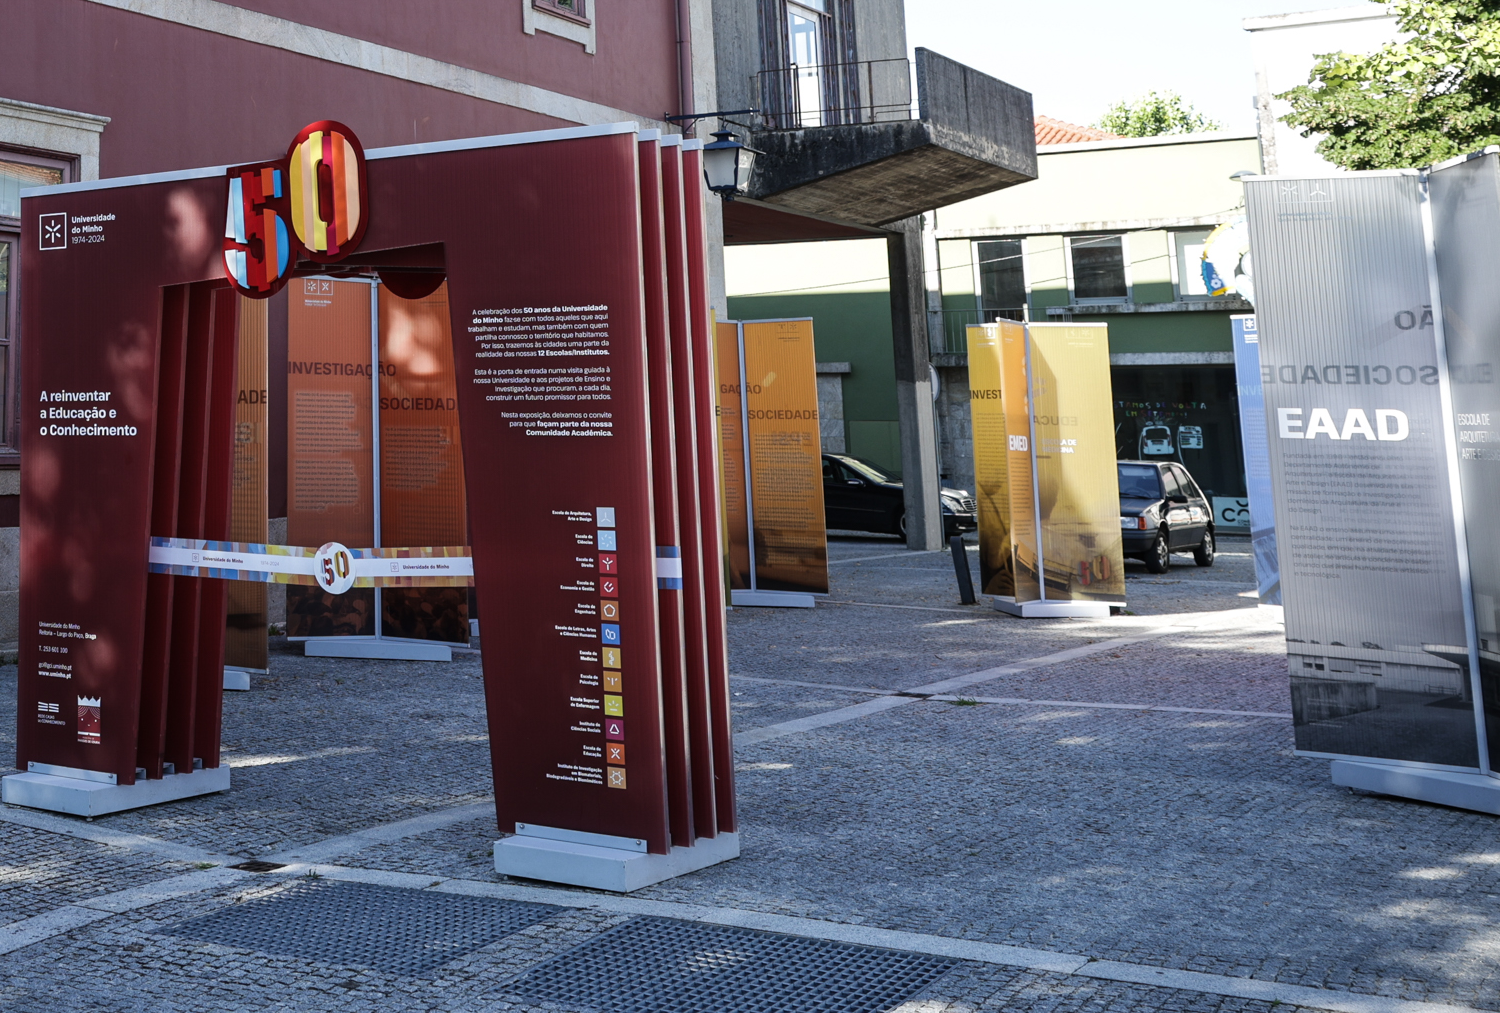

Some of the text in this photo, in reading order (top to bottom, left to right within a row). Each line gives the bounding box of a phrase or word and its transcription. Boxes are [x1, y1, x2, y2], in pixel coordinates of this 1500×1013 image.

[225, 130, 360, 292] 50
[72, 213, 115, 223] Universidade
[82, 225, 103, 233] Minho
[72, 235, 105, 244] 1974-2024
[477, 308, 510, 316] celebração
[562, 304, 608, 312] Universidade
[555, 314, 580, 322] aqueles
[595, 313, 608, 321] aqui
[288, 361, 396, 379] INVESTIGAÇÃO
[548, 376, 574, 384] projetos
[40, 390, 111, 401] A reinventar
[380, 397, 458, 411] SOCIEDAD
[1114, 401, 1151, 409] STAMOS
[40, 407, 116, 421] a Educação e
[749, 409, 818, 420] SOCIEDADE
[1457, 413, 1490, 425] ESCOLA DE
[40, 424, 137, 436] o Conhecimento
[1277, 407, 1410, 441] EAAD
[1009, 435, 1028, 451] EMED
[321, 550, 350, 586] 50
[85, 632, 96, 640] Braga
